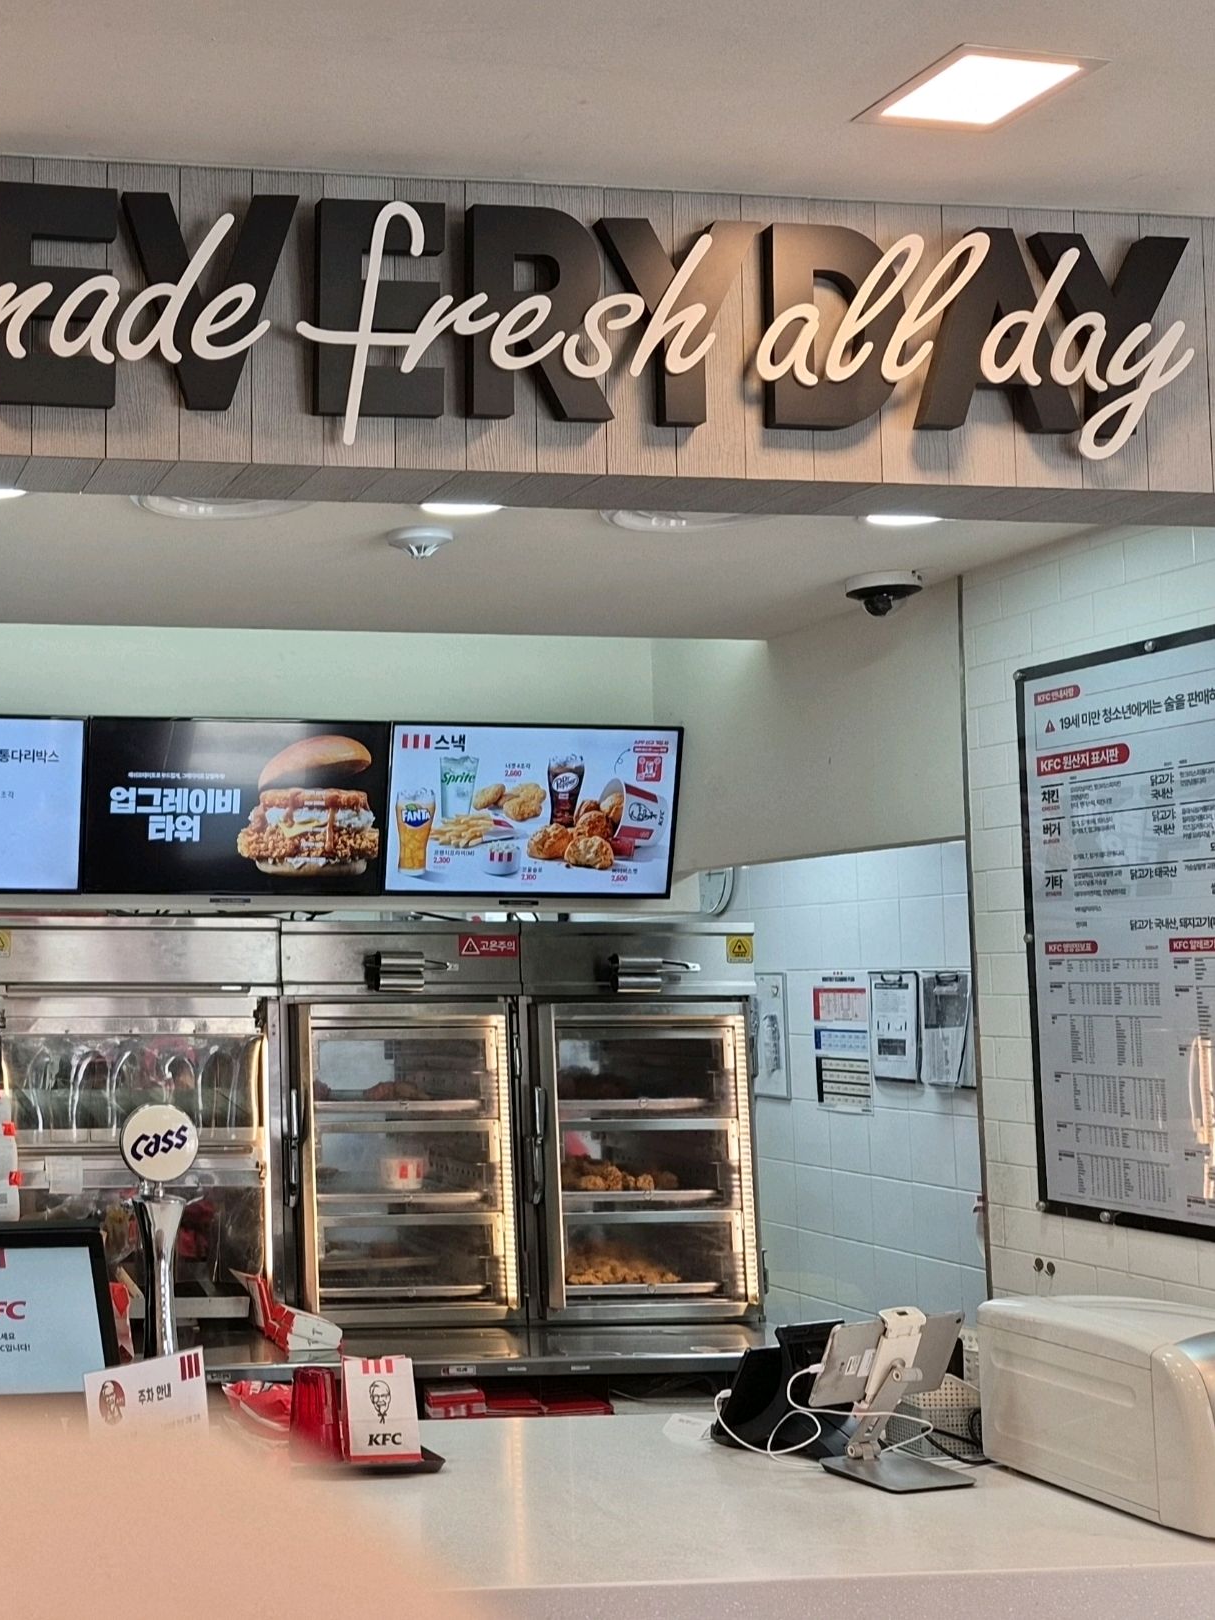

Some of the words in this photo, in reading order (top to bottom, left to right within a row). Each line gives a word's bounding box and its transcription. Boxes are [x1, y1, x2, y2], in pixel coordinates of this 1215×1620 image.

[296, 200, 716, 445] fresh
[756, 232, 991, 386] all
[980, 247, 1195, 460] day
[1037, 693, 1051, 702] KFC
[1059, 713, 1080, 730] 19세
[1082, 709, 1100, 726] 미만
[1102, 700, 1162, 724] 청소년에게는
[1164, 694, 1185, 712] 술을
[434, 734, 466, 751] 스낵
[1041, 759, 1061, 772] KFC
[1063, 752, 1089, 770] 원산지
[1091, 747, 1119, 765] 표시판
[441, 771, 475, 785] Sprite
[110, 786, 241, 814] 업그레이비
[1041, 790, 1060, 804] 치킨
[402, 810, 431, 823] FANTA
[148, 814, 201, 842] 타워
[1043, 821, 1060, 837] 버거
[1045, 874, 1063, 890] 기타
[480, 940, 515, 952] 고온주의
[1173, 941, 1188, 950] KFC
[138, 1386, 154, 1406] 주차
[156, 1382, 172, 1401] 안내
[368, 1432, 402, 1446] KFC
